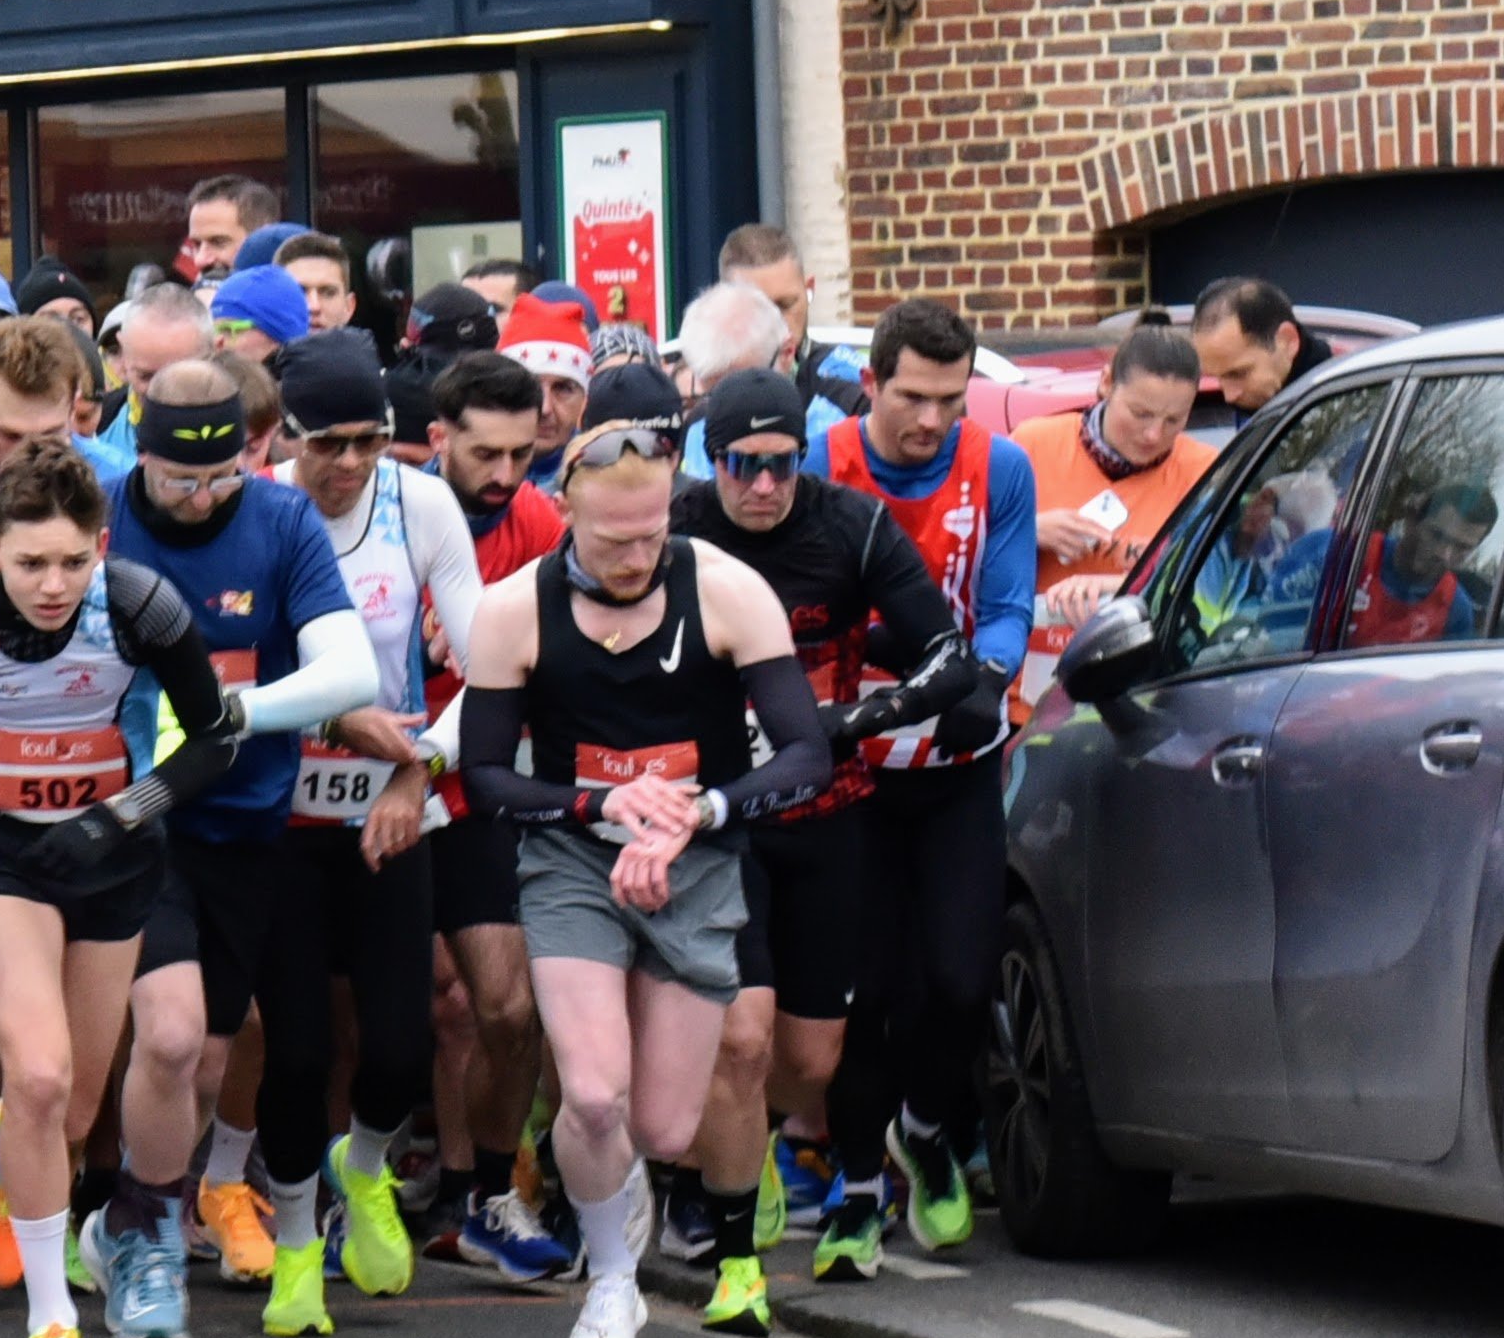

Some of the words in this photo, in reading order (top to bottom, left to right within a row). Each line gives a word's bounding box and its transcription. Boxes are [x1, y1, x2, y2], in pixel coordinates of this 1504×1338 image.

[593, 269, 619, 283] TOUS
[19, 777, 98, 809] 502
[302, 770, 371, 802] 158
